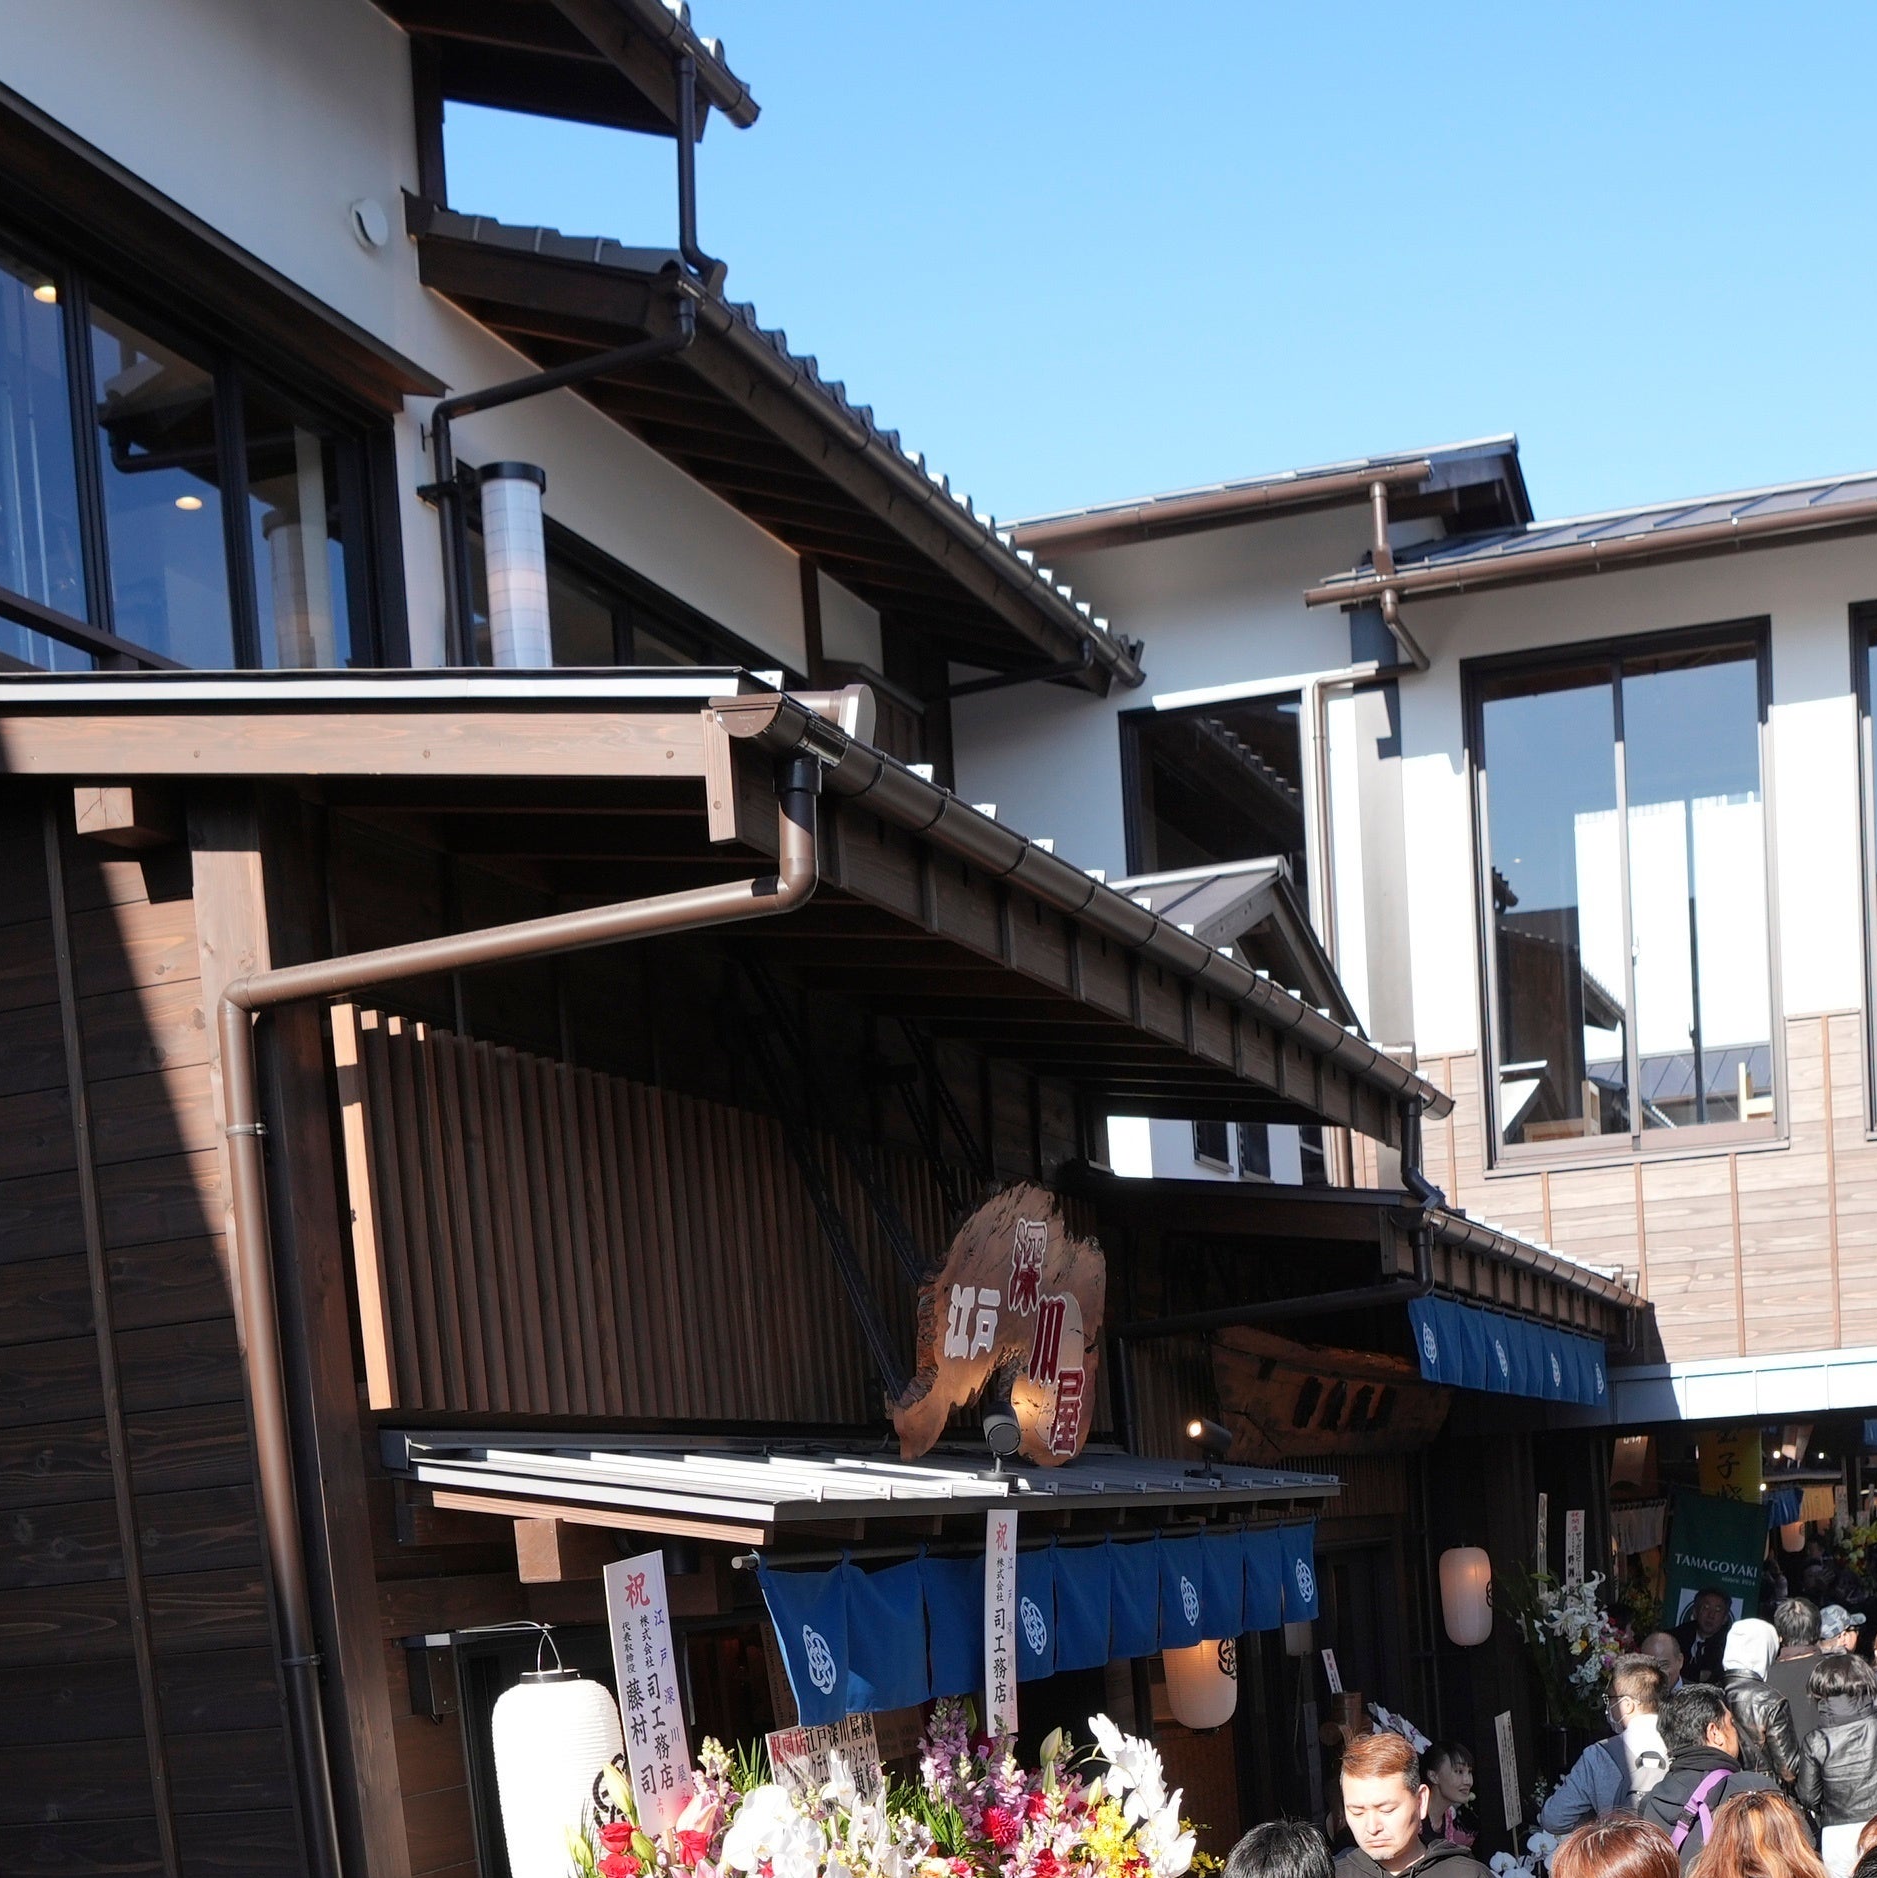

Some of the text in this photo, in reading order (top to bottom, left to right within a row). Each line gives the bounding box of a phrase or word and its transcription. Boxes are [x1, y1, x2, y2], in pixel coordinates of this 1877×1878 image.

[943, 1283, 1002, 1360] 江戸
[1008, 1217, 1085, 1456] 深川屋
[995, 1521, 1008, 1551] 祝
[1674, 1553, 1758, 1578] TAMAGOYAKI
[624, 1572, 651, 1610] 祝
